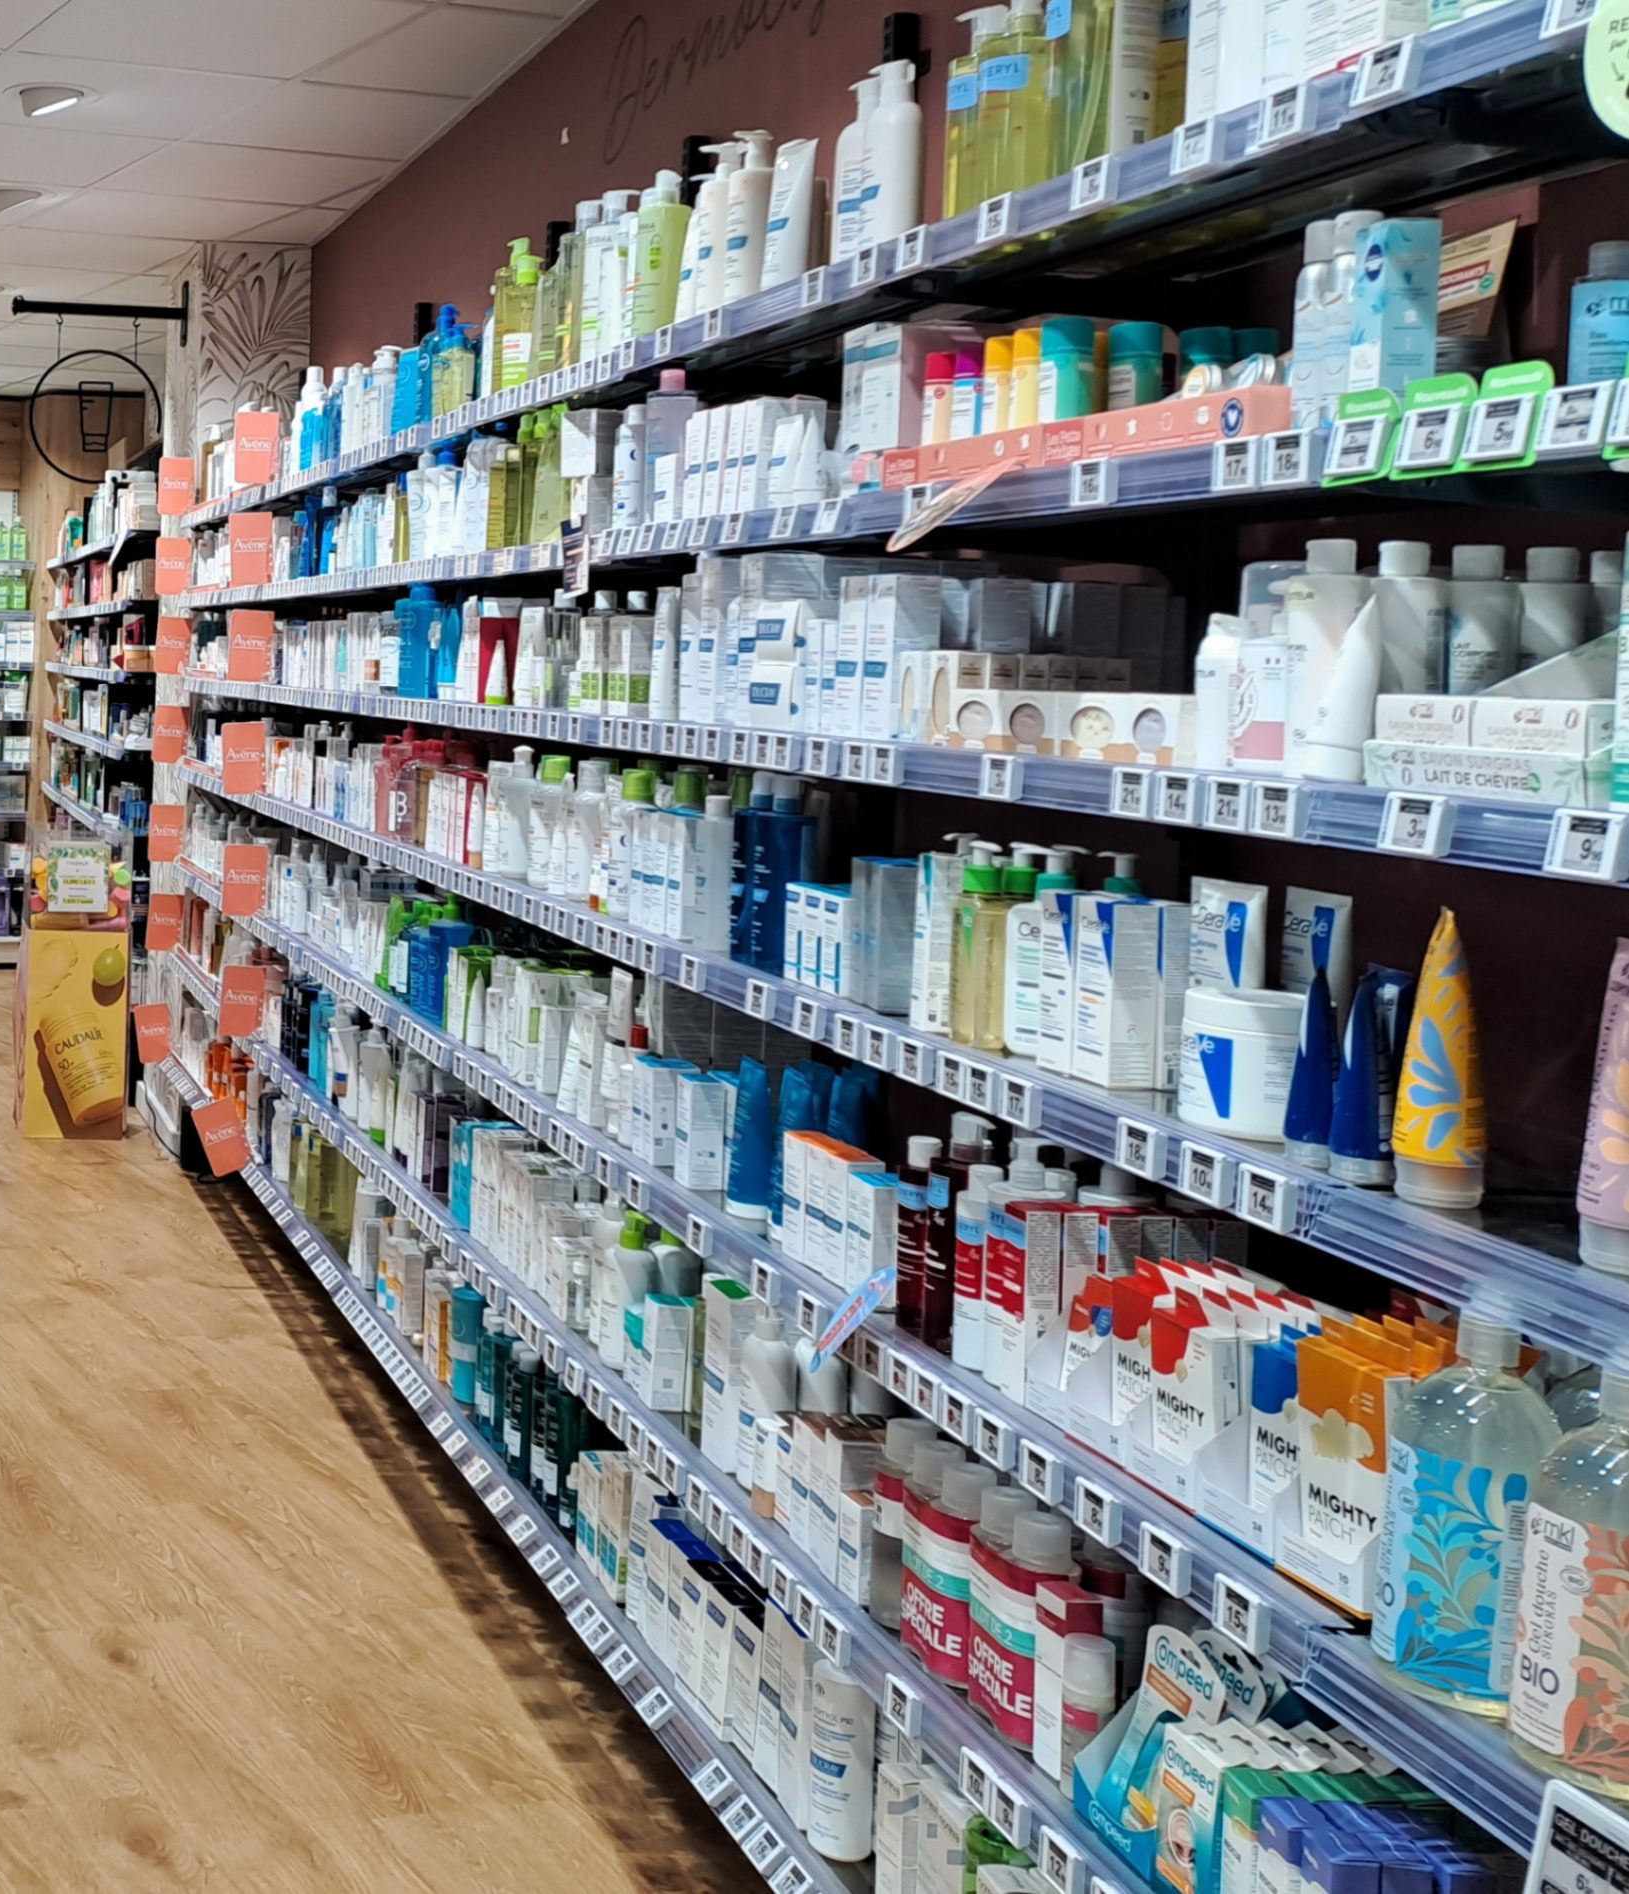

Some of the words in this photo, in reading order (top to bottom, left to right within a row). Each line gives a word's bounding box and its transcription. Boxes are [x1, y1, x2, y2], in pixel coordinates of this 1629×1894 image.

[984, 63, 1021, 78] ERYL
[1424, 769, 1451, 785] LAIT
[1454, 772, 1473, 786] DE
[1183, 1033, 1215, 1054] eraVe
[1117, 1352, 1151, 1382] MIGH
[1156, 1386, 1205, 1427] MIGHTY
[1256, 1426, 1300, 1462] MIGH
[1307, 1482, 1378, 1533] MIGHTY
[907, 1581, 945, 1628] OFFRE
[901, 1600, 963, 1658] SPECIALE
[973, 1635, 1014, 1687] OFFRE
[1520, 1655, 1560, 1696] BIO
[968, 1656, 1033, 1719] SPECIALE
